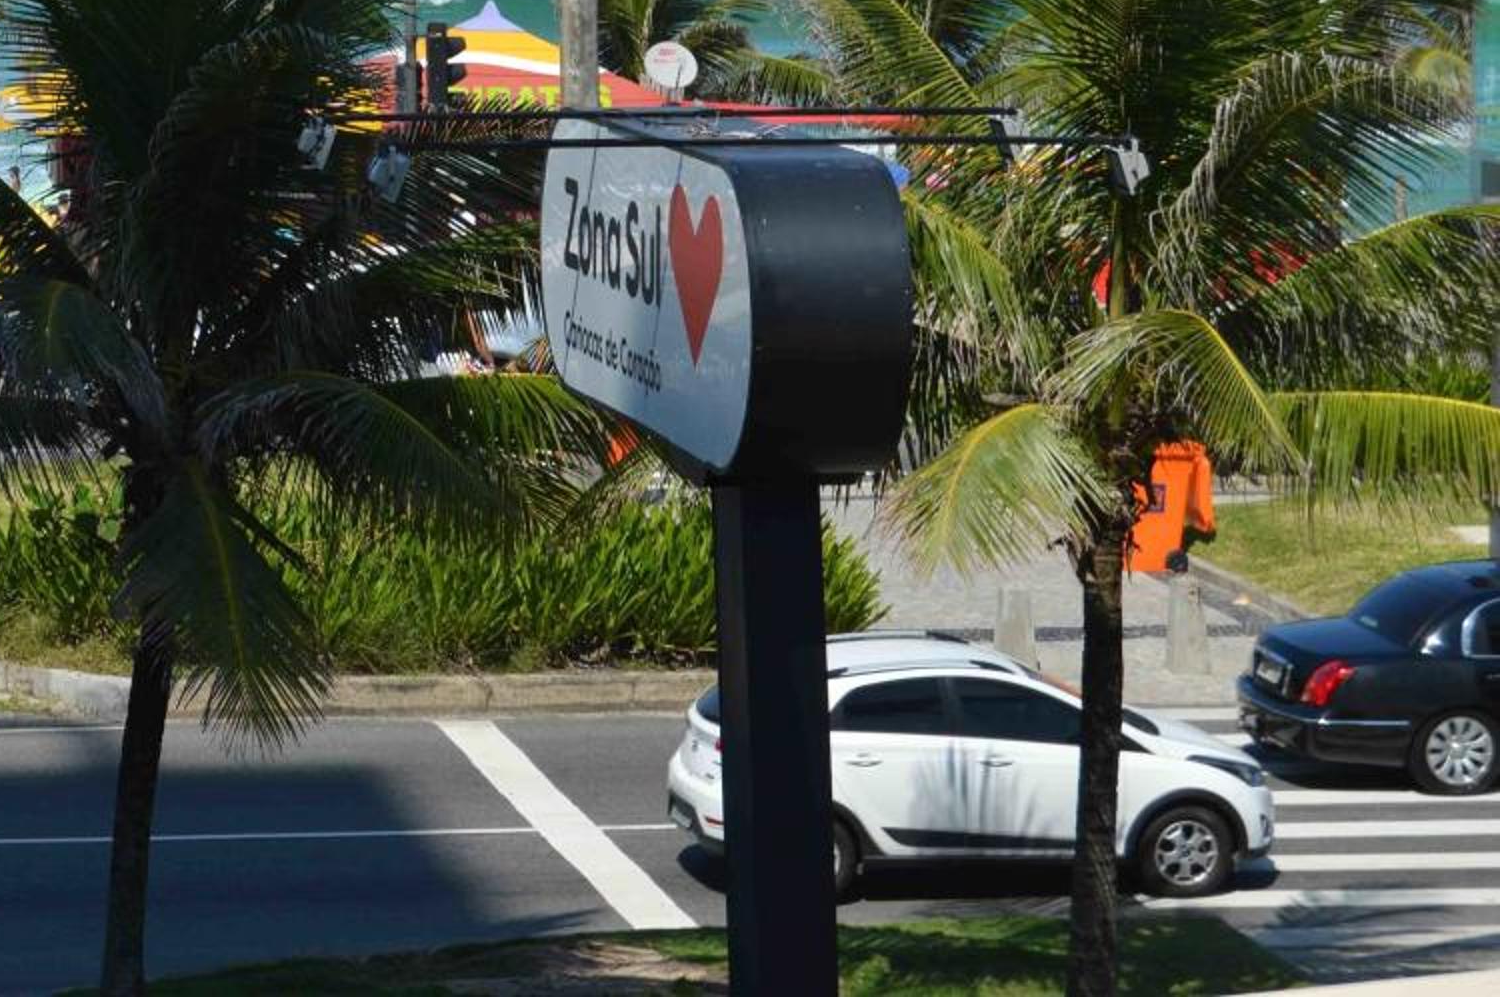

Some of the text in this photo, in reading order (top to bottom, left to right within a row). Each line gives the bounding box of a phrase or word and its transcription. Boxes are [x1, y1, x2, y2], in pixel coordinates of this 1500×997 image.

[564, 176, 661, 309] Zona Sul
[563, 311, 661, 395] Cariocas de Coração
